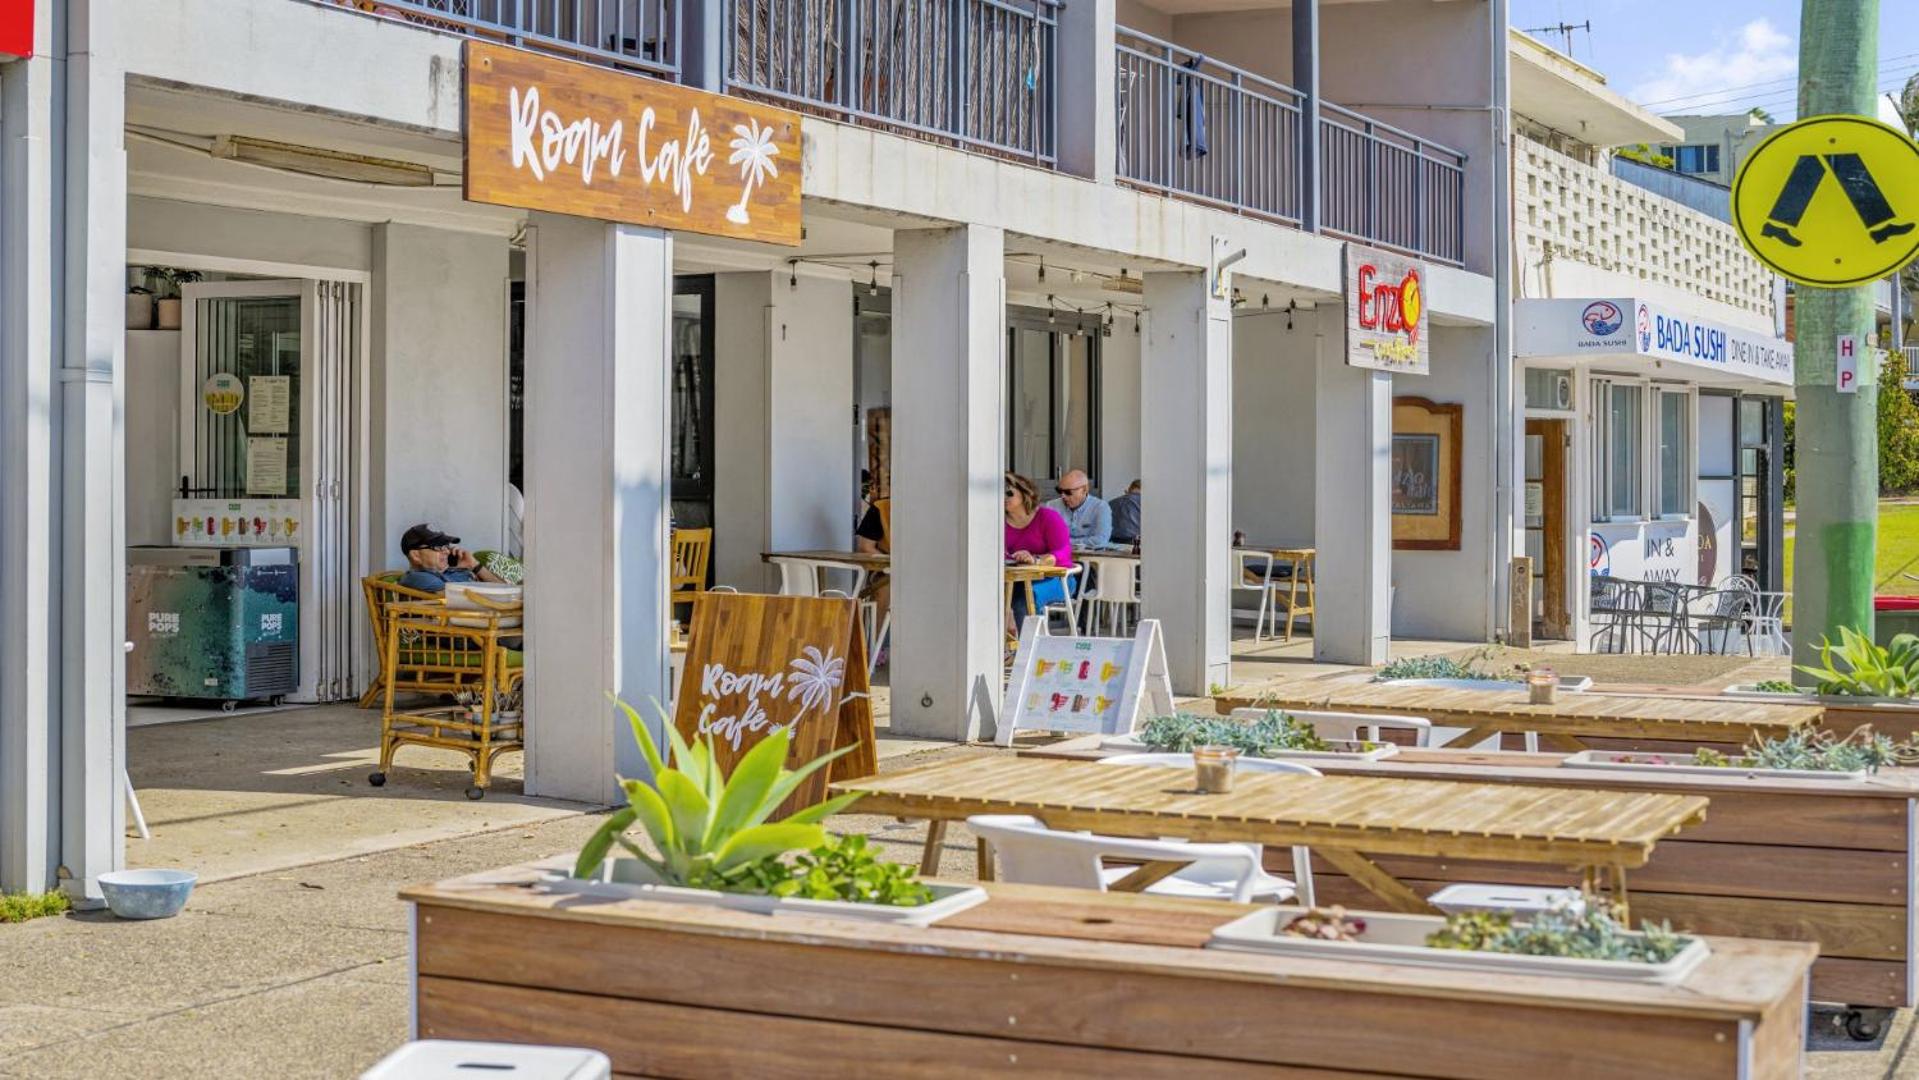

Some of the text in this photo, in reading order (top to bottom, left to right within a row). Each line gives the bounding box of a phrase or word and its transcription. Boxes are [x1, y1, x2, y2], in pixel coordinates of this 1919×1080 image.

[638, 106, 716, 214] Café
[1578, 339, 1627, 347] BADA SUSHI
[1656, 315, 1691, 356] BADA
[1694, 325, 1726, 363] SUSHI
[1647, 537, 1674, 557] IN &
[1643, 568, 1681, 582] AWAY
[148, 612, 180, 622] PURE
[261, 613, 282, 622] PURE
[148, 622, 180, 632] POPS
[699, 698, 769, 752] Café
